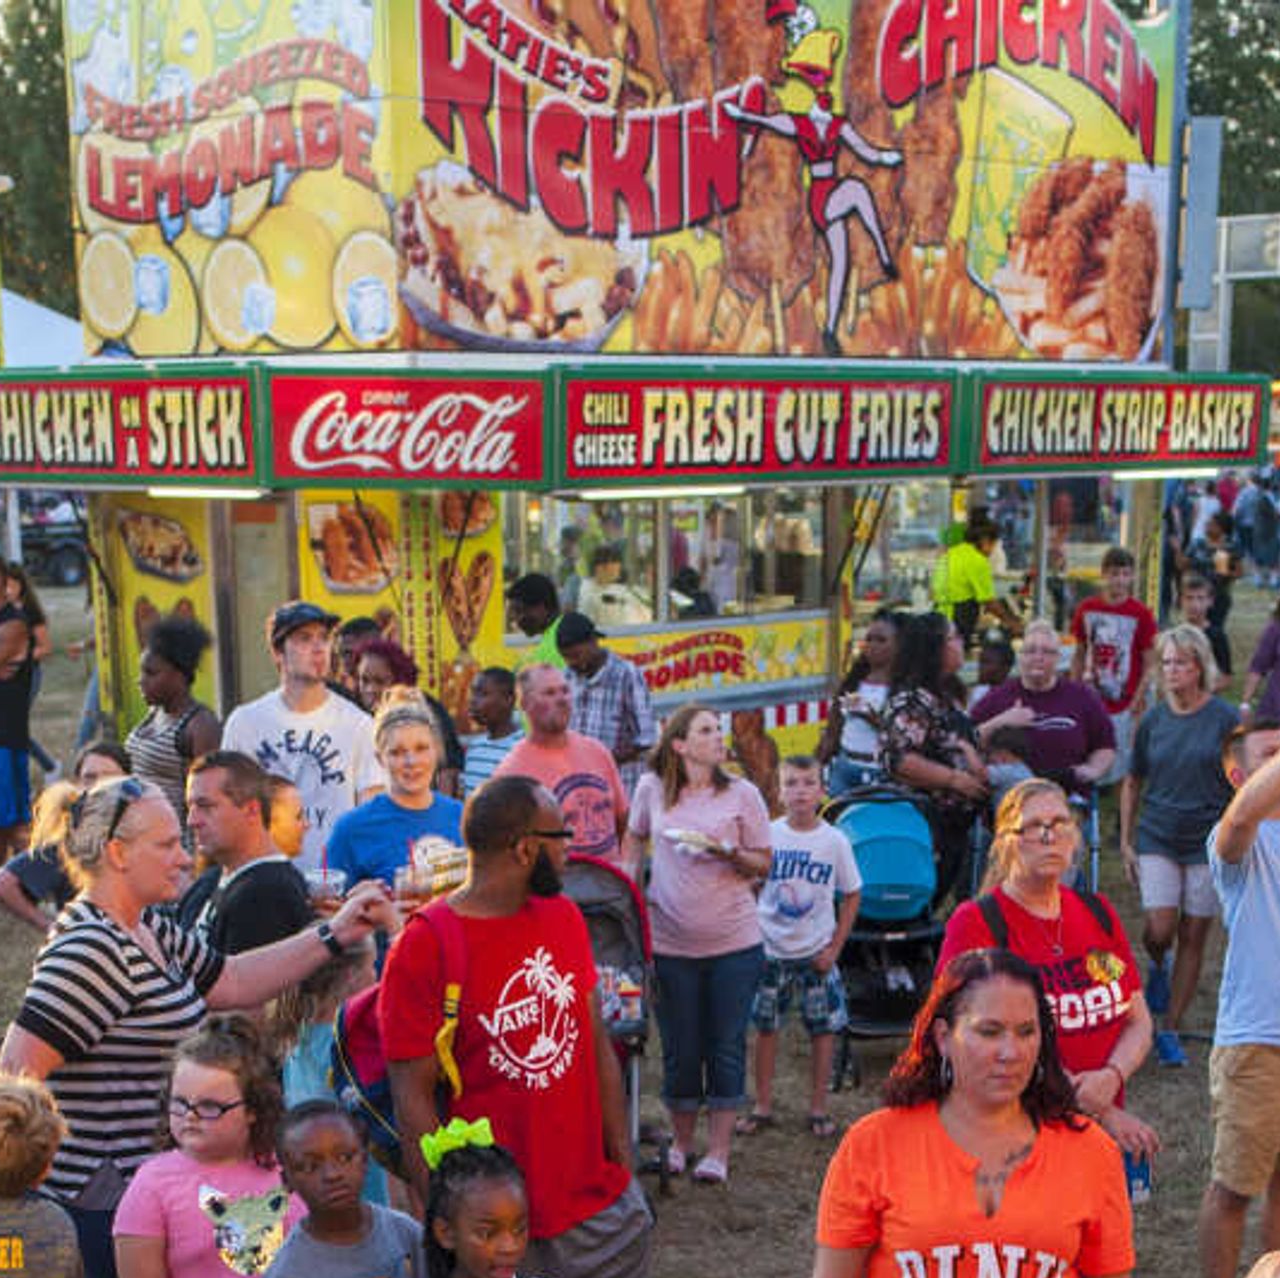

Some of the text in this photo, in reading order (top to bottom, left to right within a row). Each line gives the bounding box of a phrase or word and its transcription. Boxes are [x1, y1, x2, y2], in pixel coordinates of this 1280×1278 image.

[84, 37, 370, 140] FRESH SQUEEZED
[85, 100, 378, 223] LEMONADE
[148, 386, 247, 467] STICK
[290, 390, 530, 473] Coca-Cola
[582, 392, 631, 425] CHILI
[641, 388, 942, 467] FRESH CUT FRIES
[986, 388, 1257, 458] CHICKEN STRIP BASKET
[125, 436, 140, 468] A
[573, 432, 637, 467] CHEESE
[477, 995, 542, 1038] VANS
